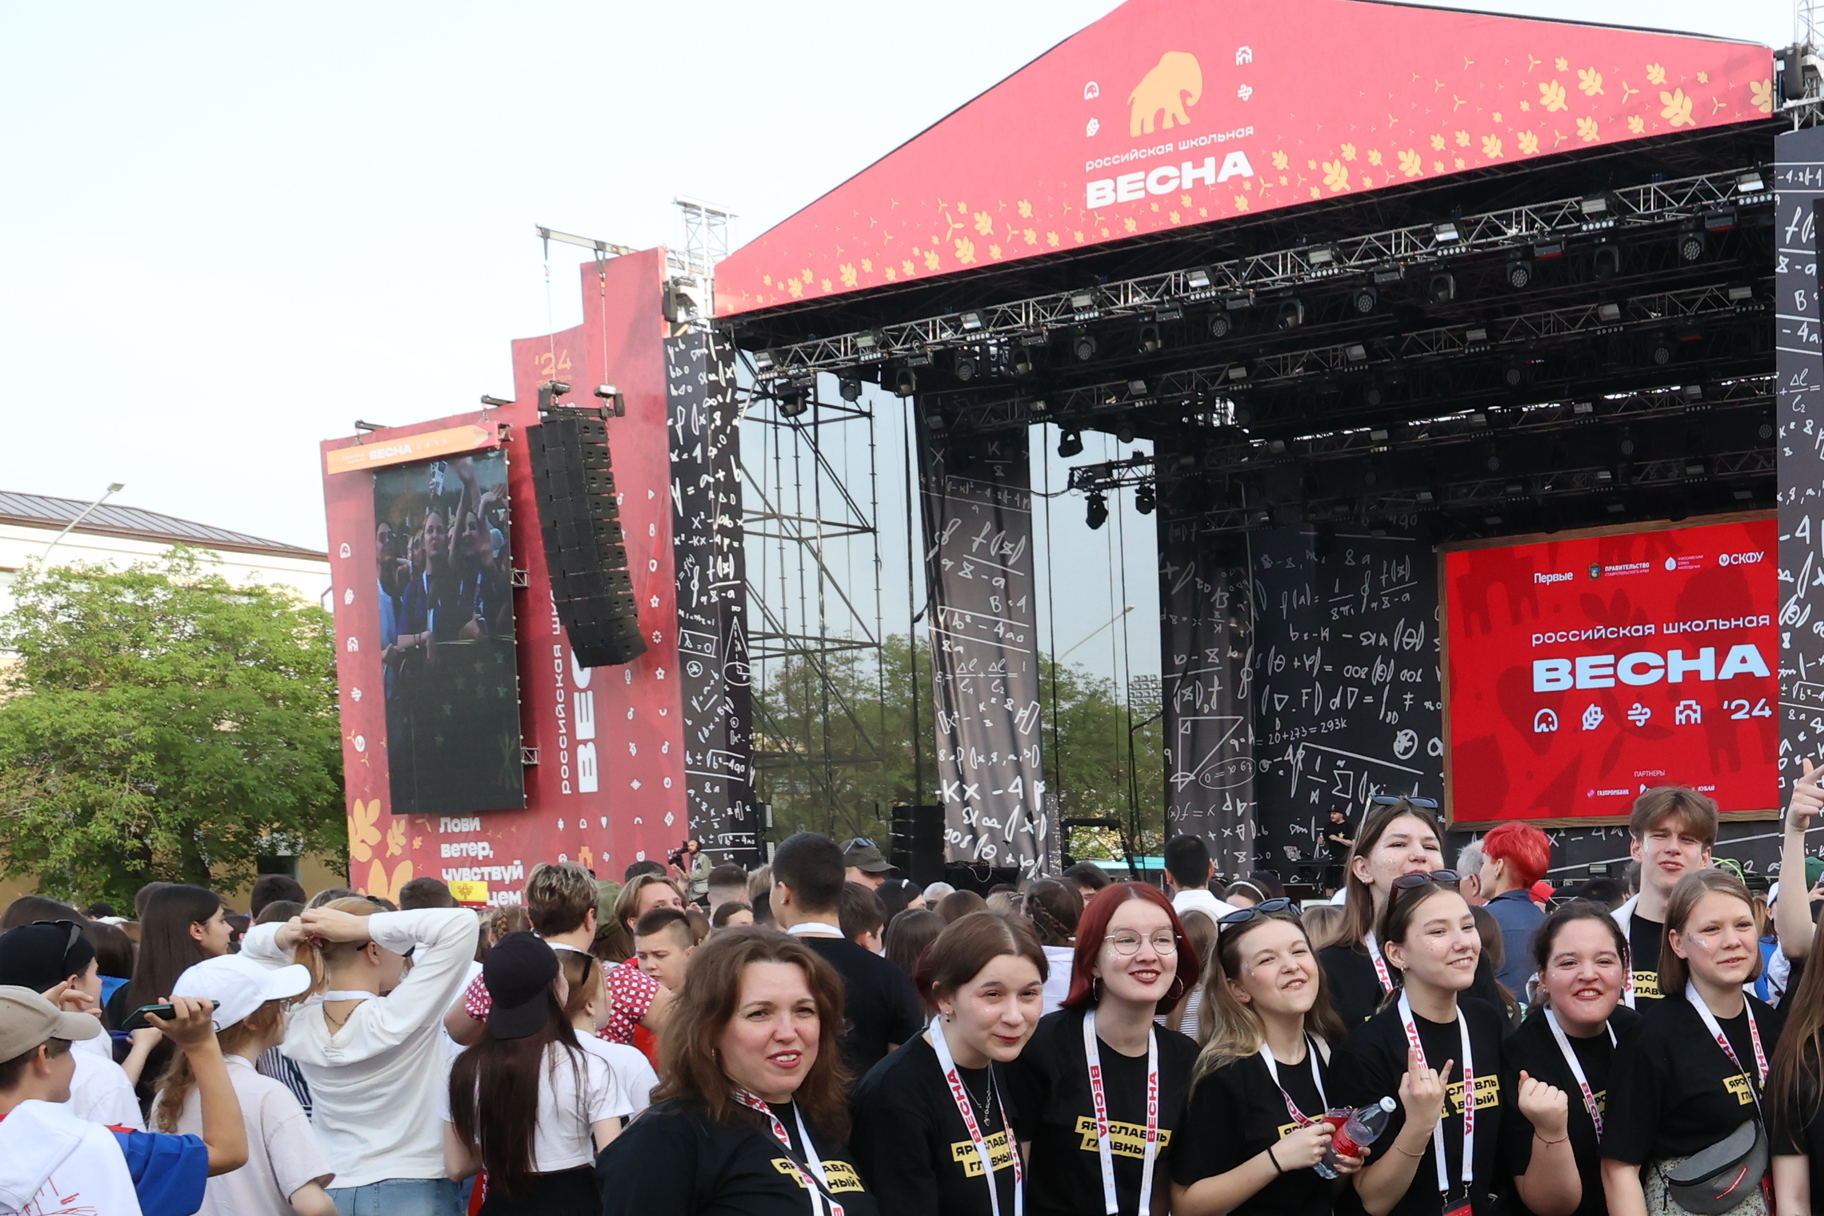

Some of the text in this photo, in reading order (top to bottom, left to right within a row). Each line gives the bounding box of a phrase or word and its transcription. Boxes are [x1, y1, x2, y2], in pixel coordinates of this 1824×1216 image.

[1085, 126, 1254, 172] российская школьная
[1086, 150, 1254, 209] ВЕСНА
[369, 443, 413, 461] ВЕСНА
[1604, 562, 1650, 571] ПРАВИТЕЛЬСТВО
[1730, 551, 1764, 565] СКФУ
[1534, 571, 1574, 585] Первые
[1531, 614, 1770, 647] российская школьная
[1532, 644, 1770, 693] ВЕСНА
[553, 645, 571, 794] российская
[1722, 698, 1772, 720] '24
[1634, 770, 1665, 778] ПАРТНЕРЫ
[439, 817, 481, 833] Лови
[441, 841, 494, 860] ветер,
[442, 860, 524, 884] чувствуй
[947, 1069, 982, 1143] ВЕСНА
[1090, 1065, 1108, 1138] ВЕСНА
[1147, 1072, 1157, 1142] ВЕСНА
[1464, 1068, 1473, 1136] ВЕСНА
